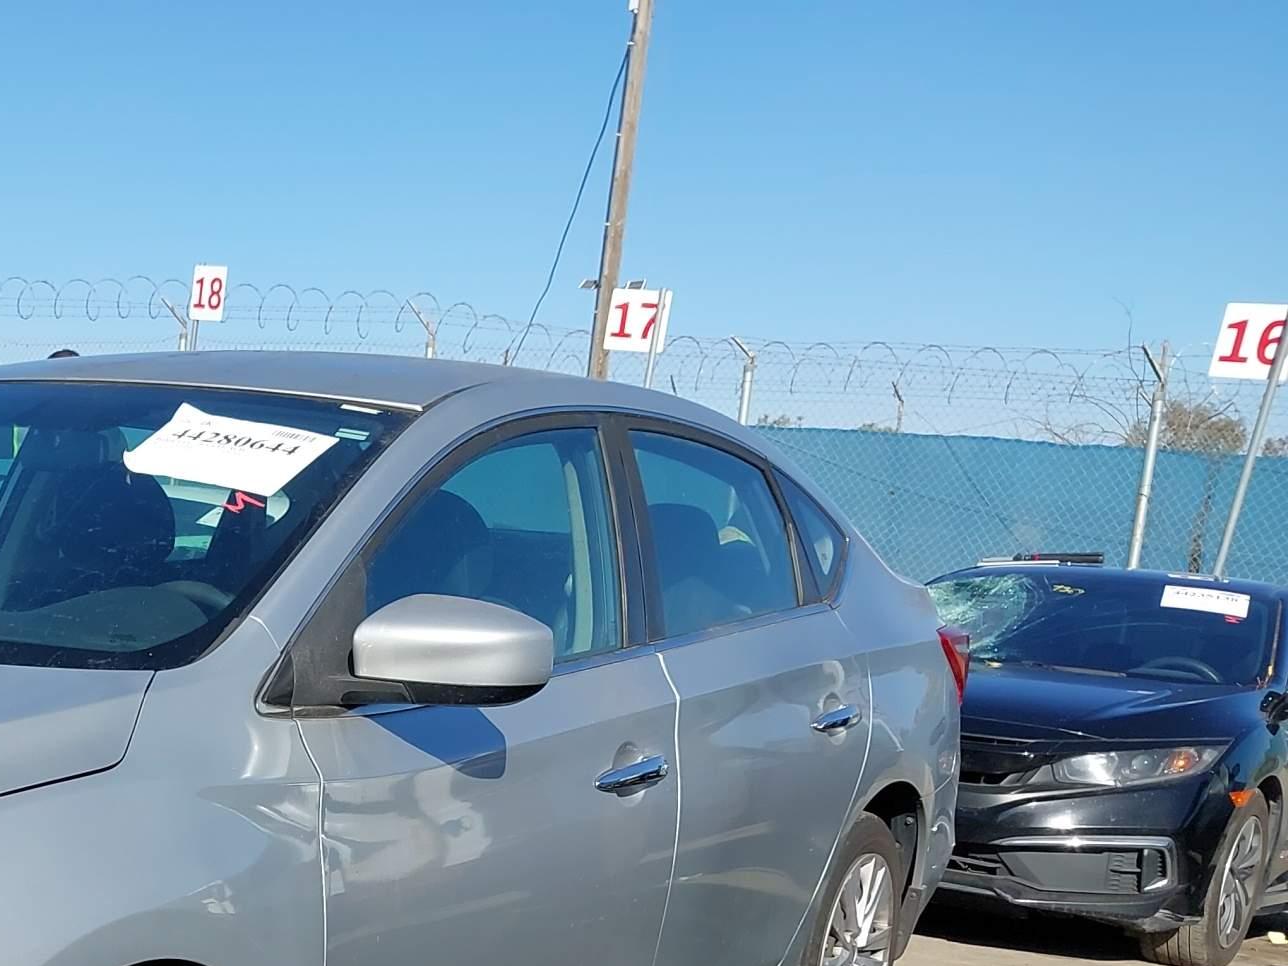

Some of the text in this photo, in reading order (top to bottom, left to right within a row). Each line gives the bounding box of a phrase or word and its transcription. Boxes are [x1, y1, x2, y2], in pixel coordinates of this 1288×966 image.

[193, 277, 222, 310] 18
[610, 302, 665, 339] 17
[1218, 319, 1288, 366] 16
[172, 429, 301, 455] 44280644
